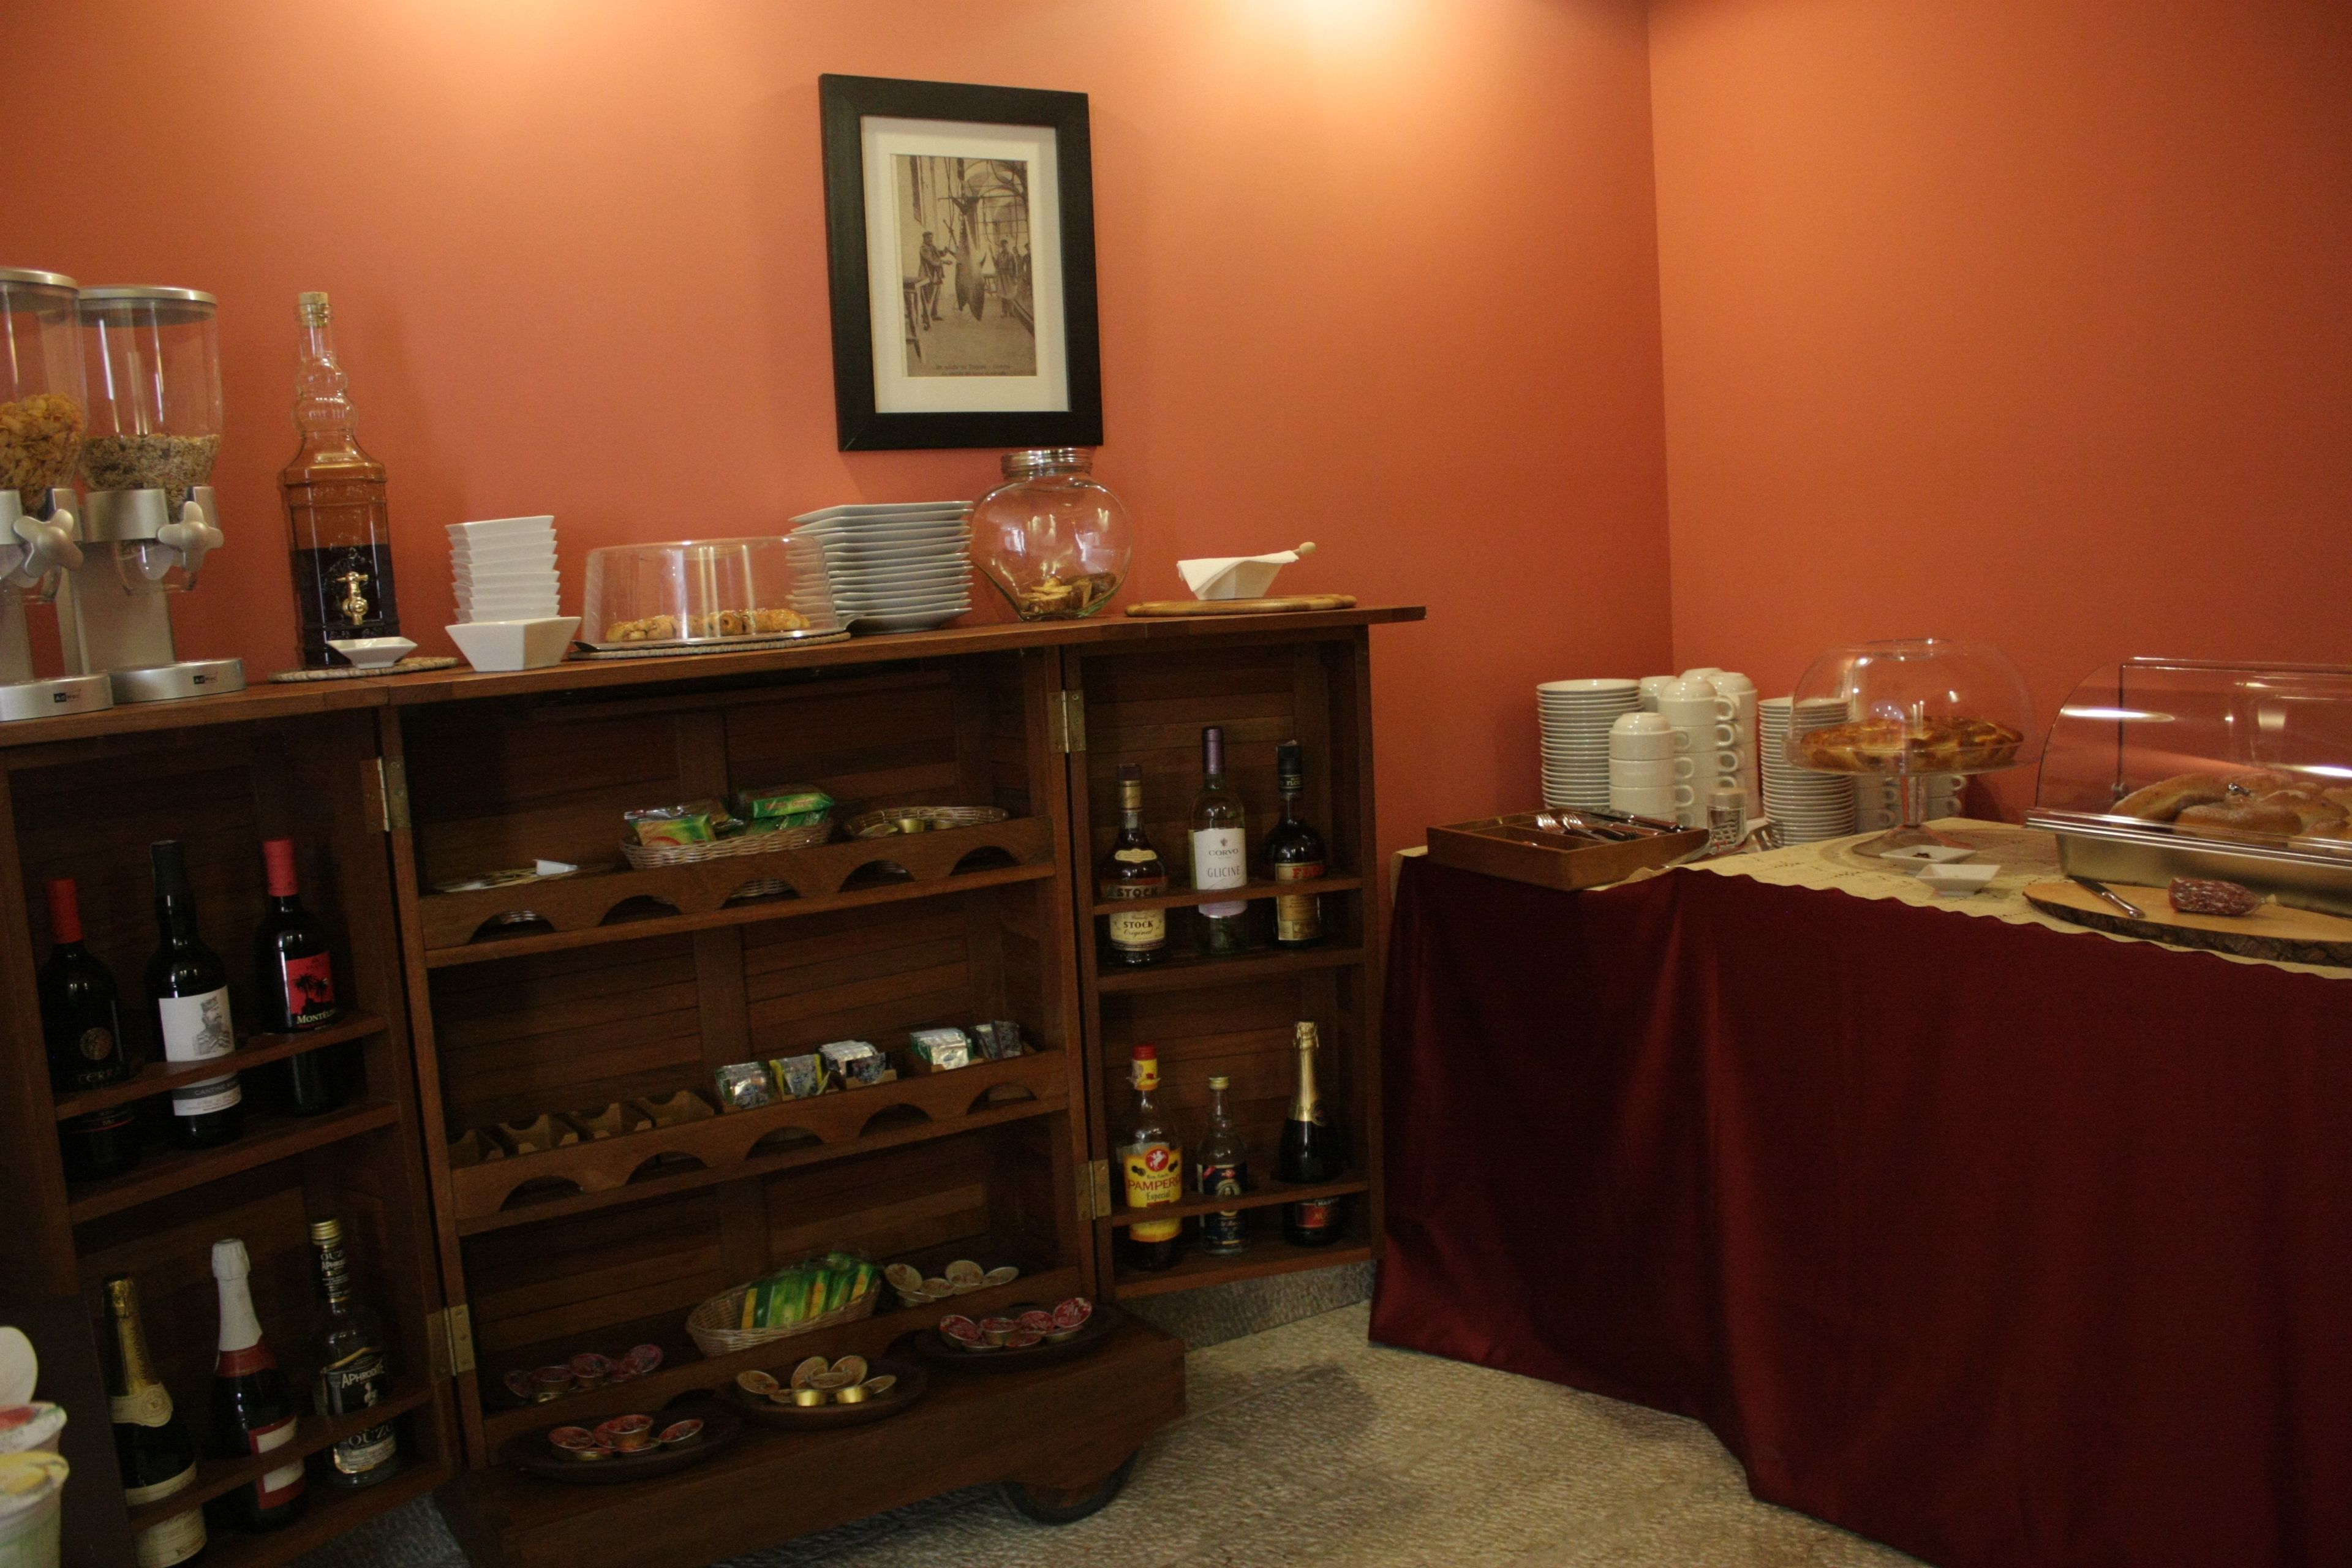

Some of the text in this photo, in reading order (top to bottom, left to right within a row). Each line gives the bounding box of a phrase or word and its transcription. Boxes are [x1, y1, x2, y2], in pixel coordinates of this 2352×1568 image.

[1207, 865, 1240, 878] GLICINE
[1117, 888, 1158, 898] STOCK
[1123, 920, 1153, 929] STOCK
[1128, 1174, 1181, 1191] PAMPERO
